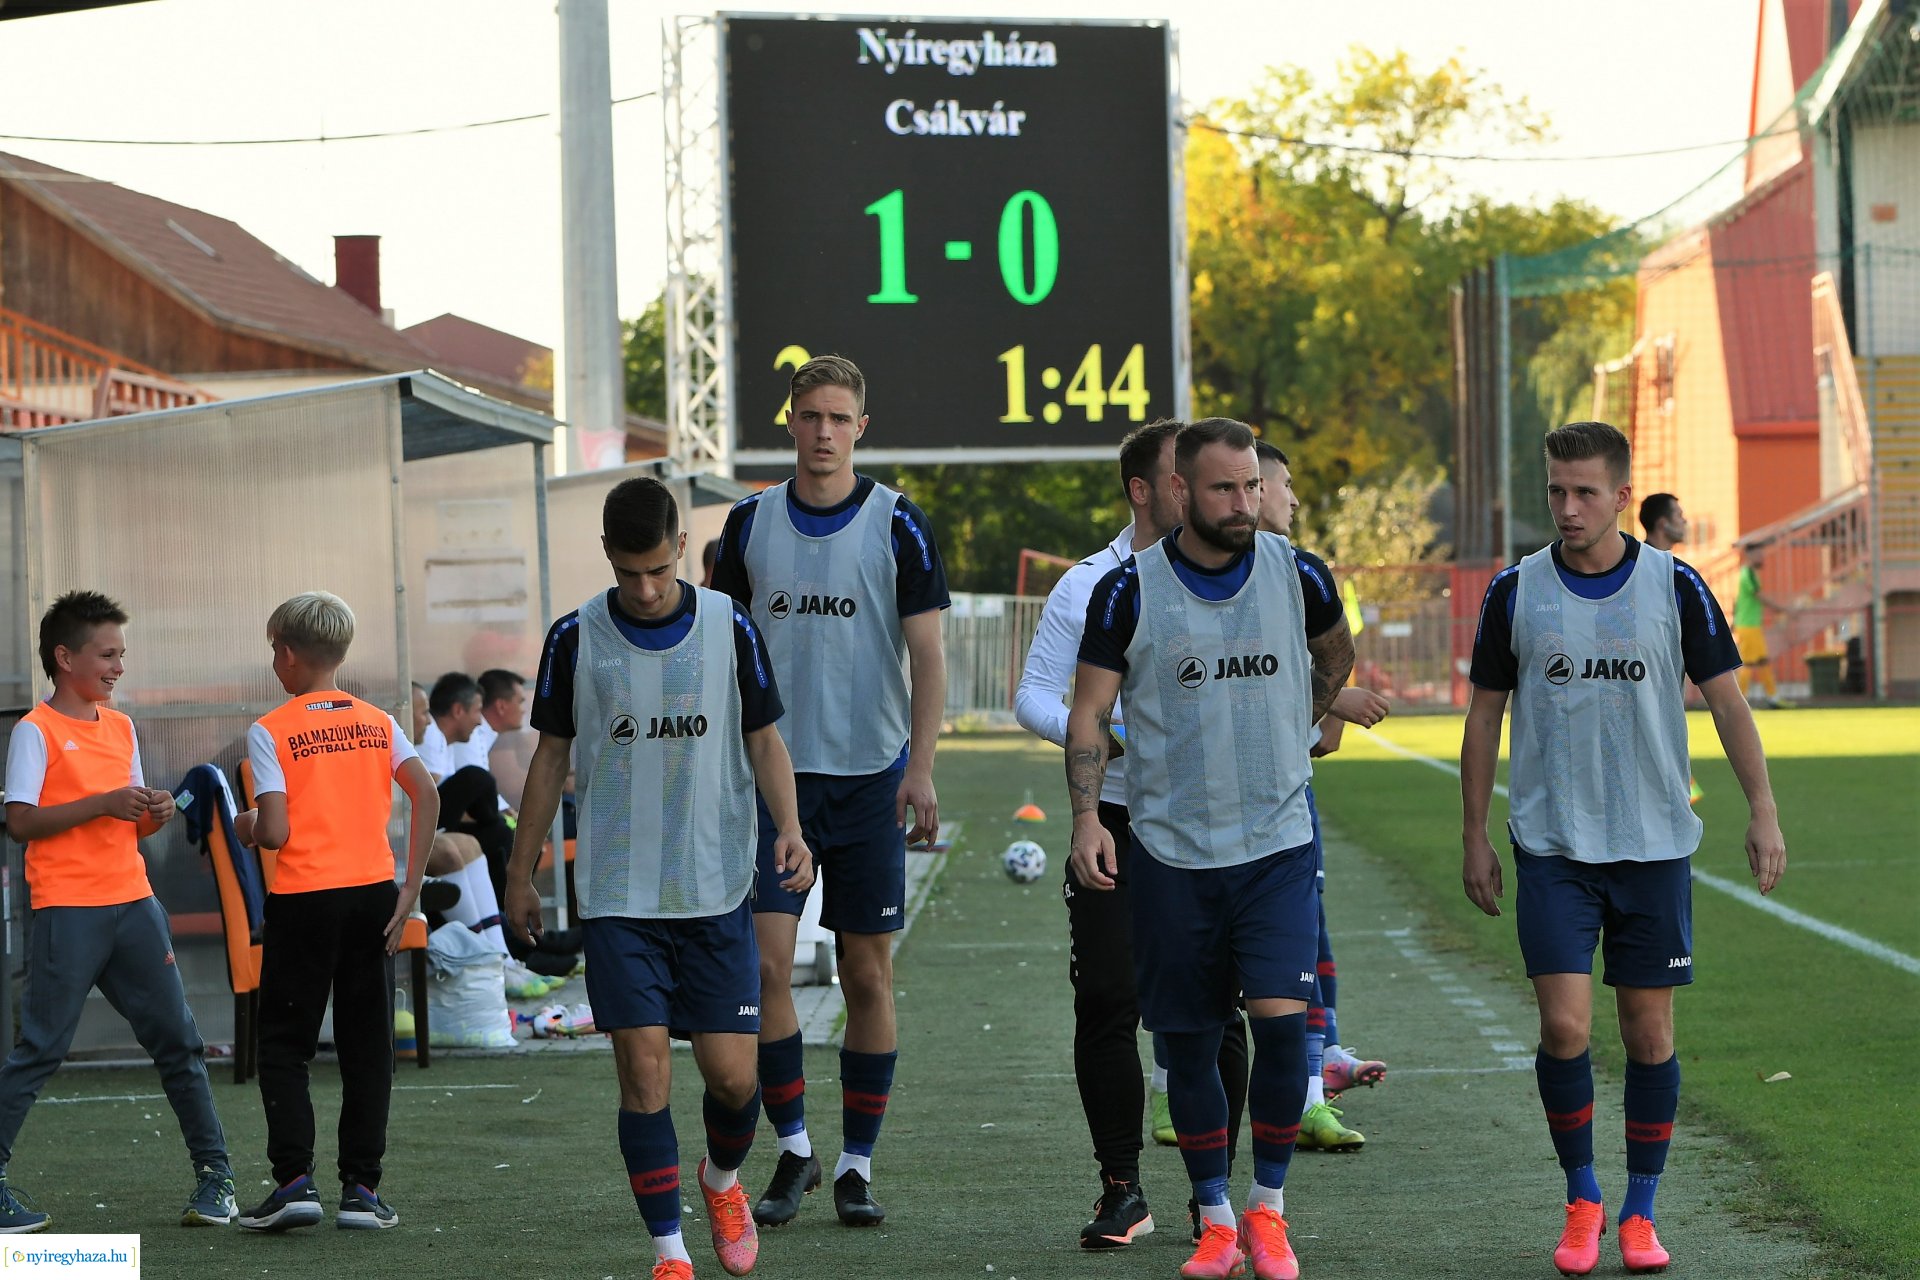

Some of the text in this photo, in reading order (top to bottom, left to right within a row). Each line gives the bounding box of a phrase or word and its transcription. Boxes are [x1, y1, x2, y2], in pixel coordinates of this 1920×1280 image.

[857, 28, 1057, 74] Nyíregyháza
[885, 99, 1026, 136] Csákvár
[864, 190, 918, 304] 1
[998, 190, 1059, 305] 0
[998, 344, 1150, 424] 1:44
[796, 593, 856, 618] JAKO
[1536, 603, 1560, 612] JAKO
[1213, 653, 1279, 680] JAKO
[1580, 658, 1646, 681] JAKO
[287, 722, 387, 751] BALMAZÚJVÁROSI
[646, 714, 708, 739] JAKO
[293, 739, 388, 761] FOOTBALL CLUB
[1668, 956, 1692, 968] JAKO
[737, 1005, 759, 1016] JAKO
